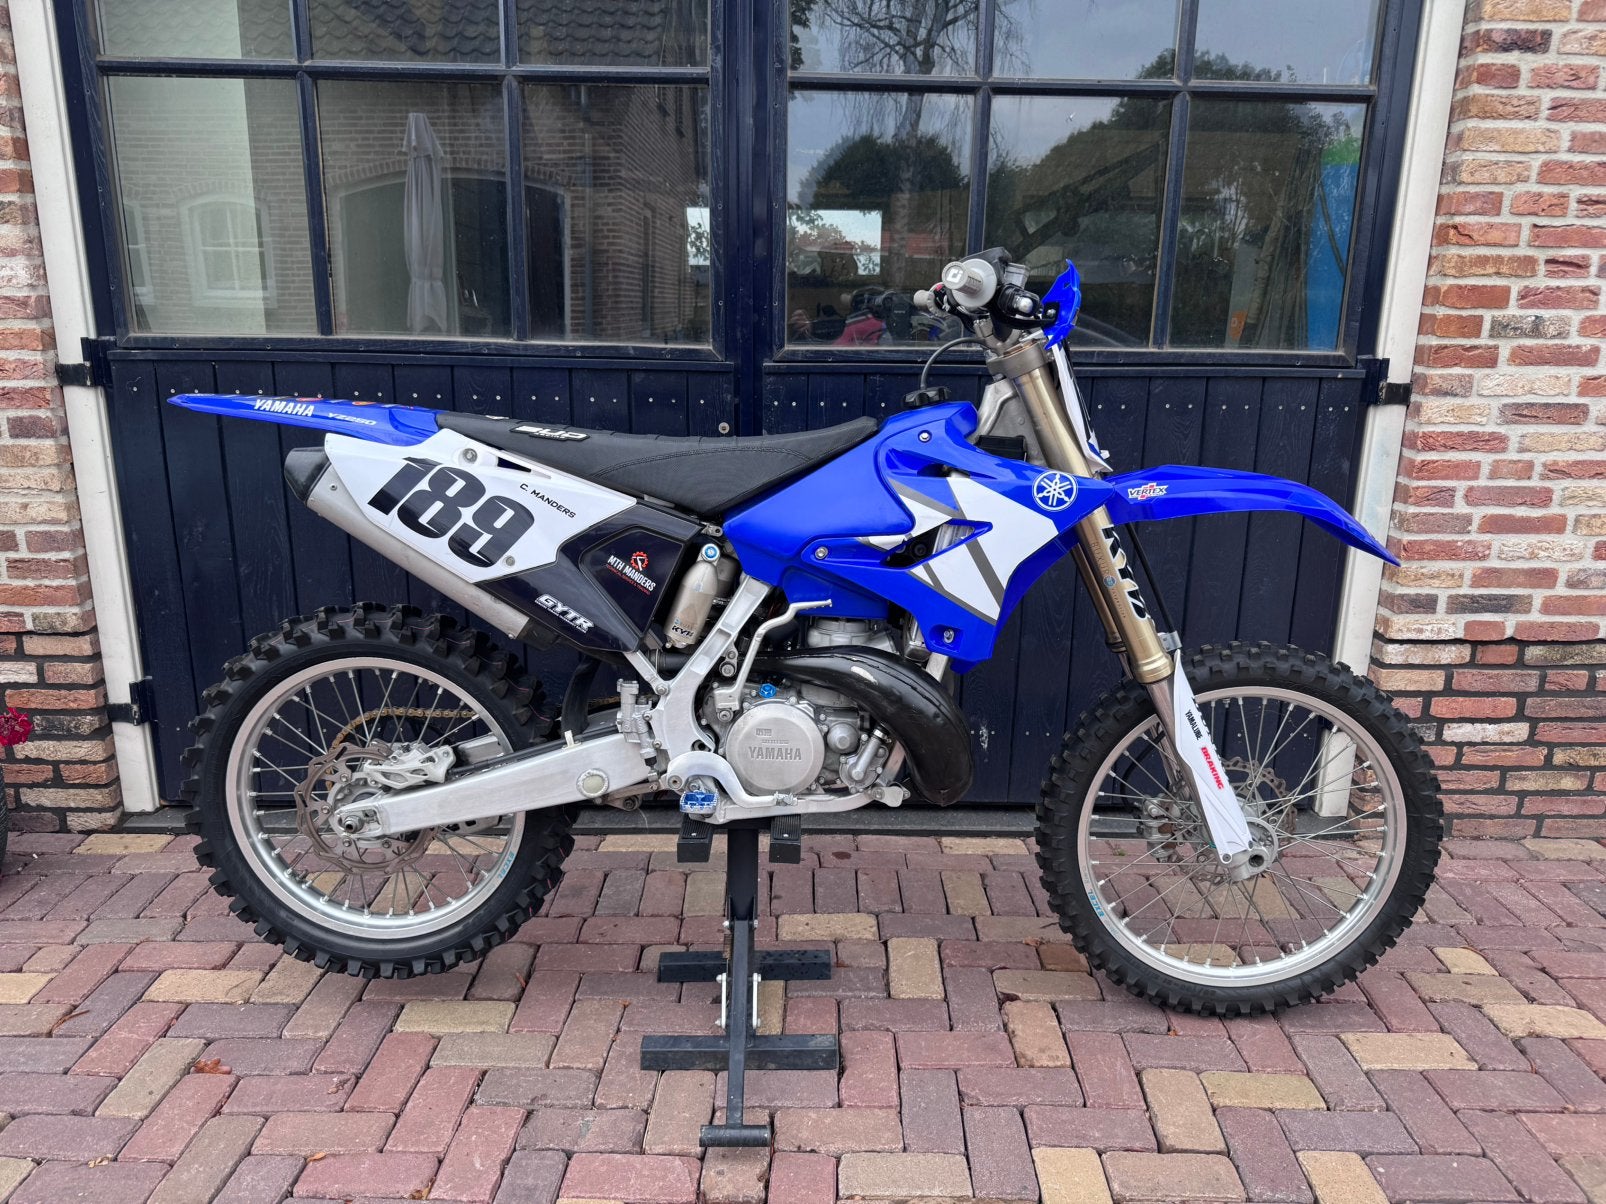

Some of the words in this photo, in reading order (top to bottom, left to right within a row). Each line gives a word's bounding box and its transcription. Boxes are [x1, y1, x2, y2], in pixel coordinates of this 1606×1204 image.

[253, 399, 315, 417] YAMAHA
[328, 412, 377, 426] YZ250
[519, 483, 528, 492] C.
[530, 488, 577, 519] MANDERS
[1129, 487, 1165, 497] VERTEX
[367, 456, 535, 568] 189
[607, 555, 625, 571] MTH
[622, 565, 656, 592] MANDERS
[536, 594, 595, 630] GYTR
[1184, 709, 1204, 741] YAMALUBE
[748, 746, 802, 761] YAMAHA
[1200, 746, 1225, 790] BRAKING
[1088, 888, 1105, 917] EXCEL
